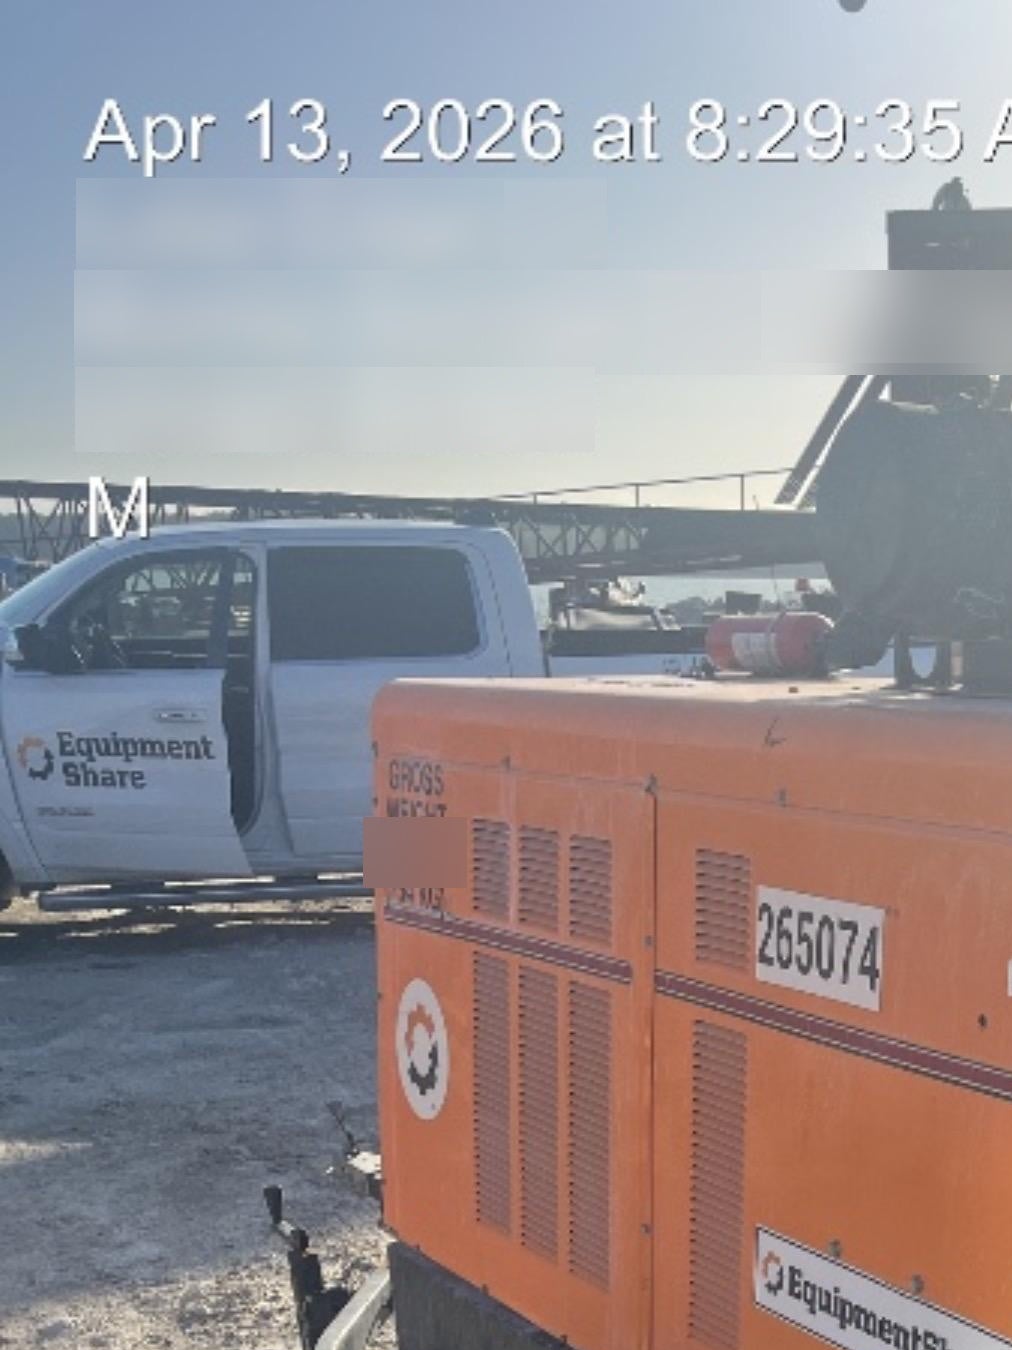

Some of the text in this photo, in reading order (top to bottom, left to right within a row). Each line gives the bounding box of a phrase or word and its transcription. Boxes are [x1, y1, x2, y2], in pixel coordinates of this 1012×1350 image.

[56, 731, 215, 762] Equipment
[62, 761, 147, 789] Share
[388, 759, 445, 796] GROSS
[757, 902, 880, 992] 265074
